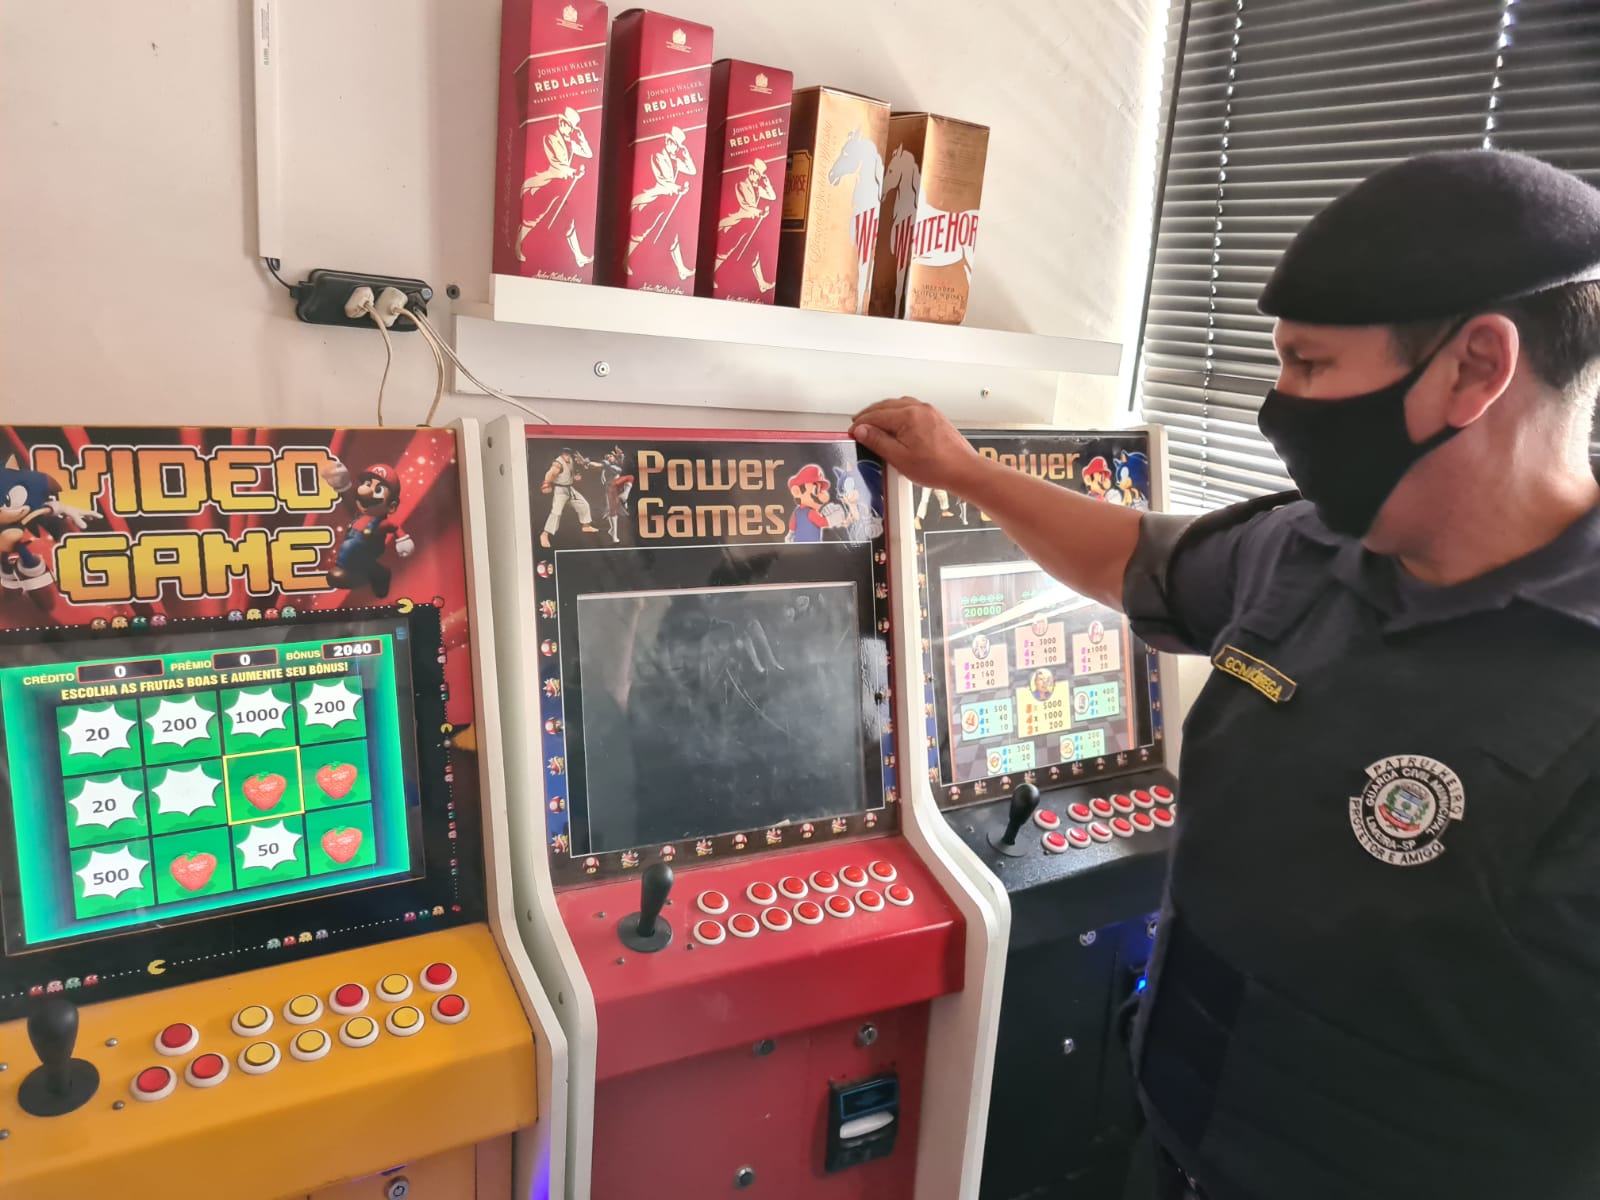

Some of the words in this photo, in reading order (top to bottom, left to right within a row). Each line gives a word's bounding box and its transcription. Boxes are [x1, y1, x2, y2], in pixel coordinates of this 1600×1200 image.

[534, 79, 559, 92] RED
[643, 100, 667, 113] RED
[730, 135, 750, 147] RED
[30, 445, 342, 516] VIDEO
[637, 450, 785, 492] Power
[637, 497, 786, 539] Games
[54, 527, 335, 606] GAME
[170, 660, 212, 672] PRÊMIO
[240, 654, 251, 666] 0
[286, 650, 321, 661] BÔNUS
[333, 643, 372, 657] 2040
[61, 685, 117, 700] ESCOLHA
[121, 683, 137, 695] AS
[140, 679, 184, 693] FRUTAS
[187, 675, 218, 687] BOAS
[220, 674, 228, 684] E
[231, 668, 283, 683] AUMENTE
[285, 665, 307, 677] SEU
[309, 661, 349, 675] BÔNUS!
[114, 665, 127, 678] 0
[85, 726, 110, 742] 20
[162, 716, 198, 734] 200
[235, 707, 280, 725] 1000
[314, 699, 346, 715] 200
[1372, 757, 1463, 815] PATRULHEIRO
[92, 798, 117, 814] 20
[1352, 800, 1386, 858] PROTETOR
[1388, 853, 1397, 862] E
[1401, 842, 1442, 864] AMIGO
[92, 867, 130, 886] 500
[257, 842, 280, 857] 50
